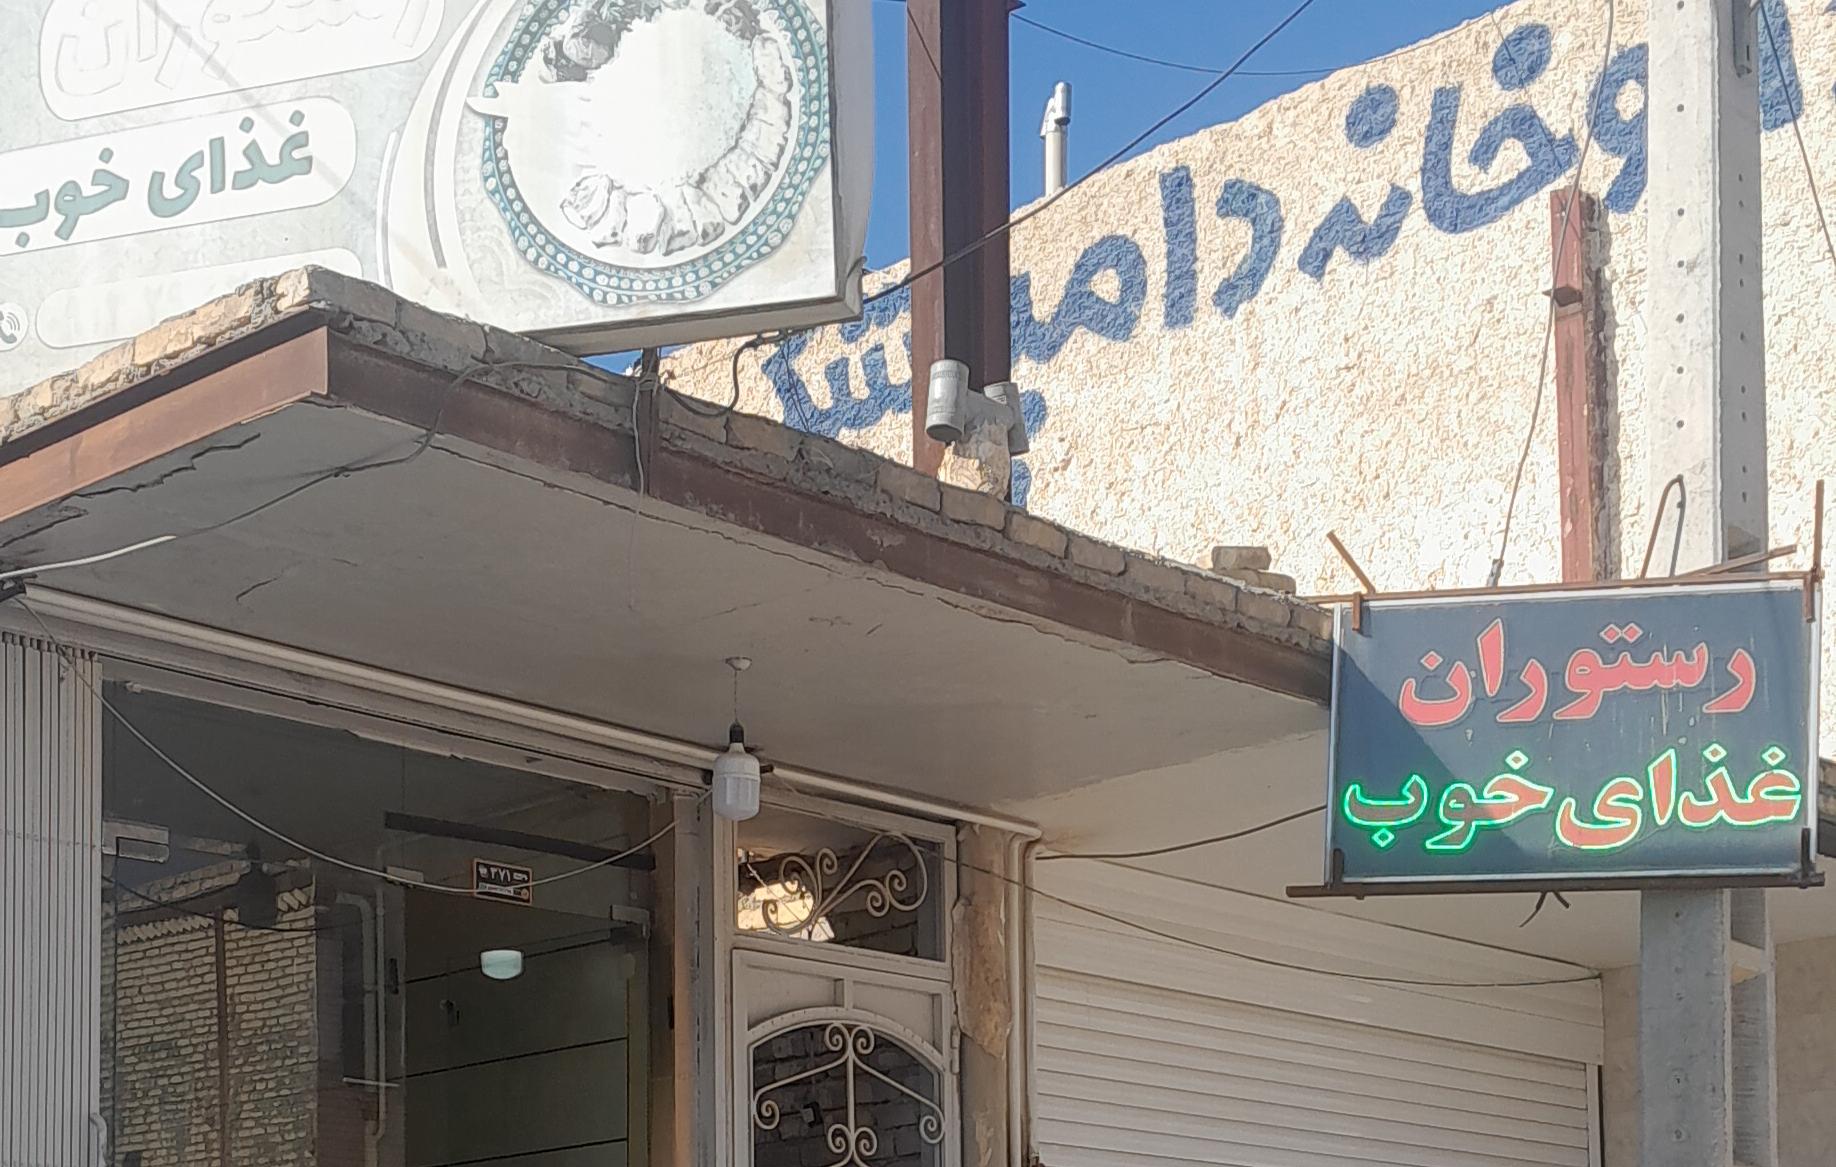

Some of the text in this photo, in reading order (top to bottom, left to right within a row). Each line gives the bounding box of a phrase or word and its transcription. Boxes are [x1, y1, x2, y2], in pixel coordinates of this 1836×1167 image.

[0, 109, 314, 248] غذای خوب
[1399, 617, 1757, 726] رستوران
[1343, 743, 1802, 851] غذای خوب
